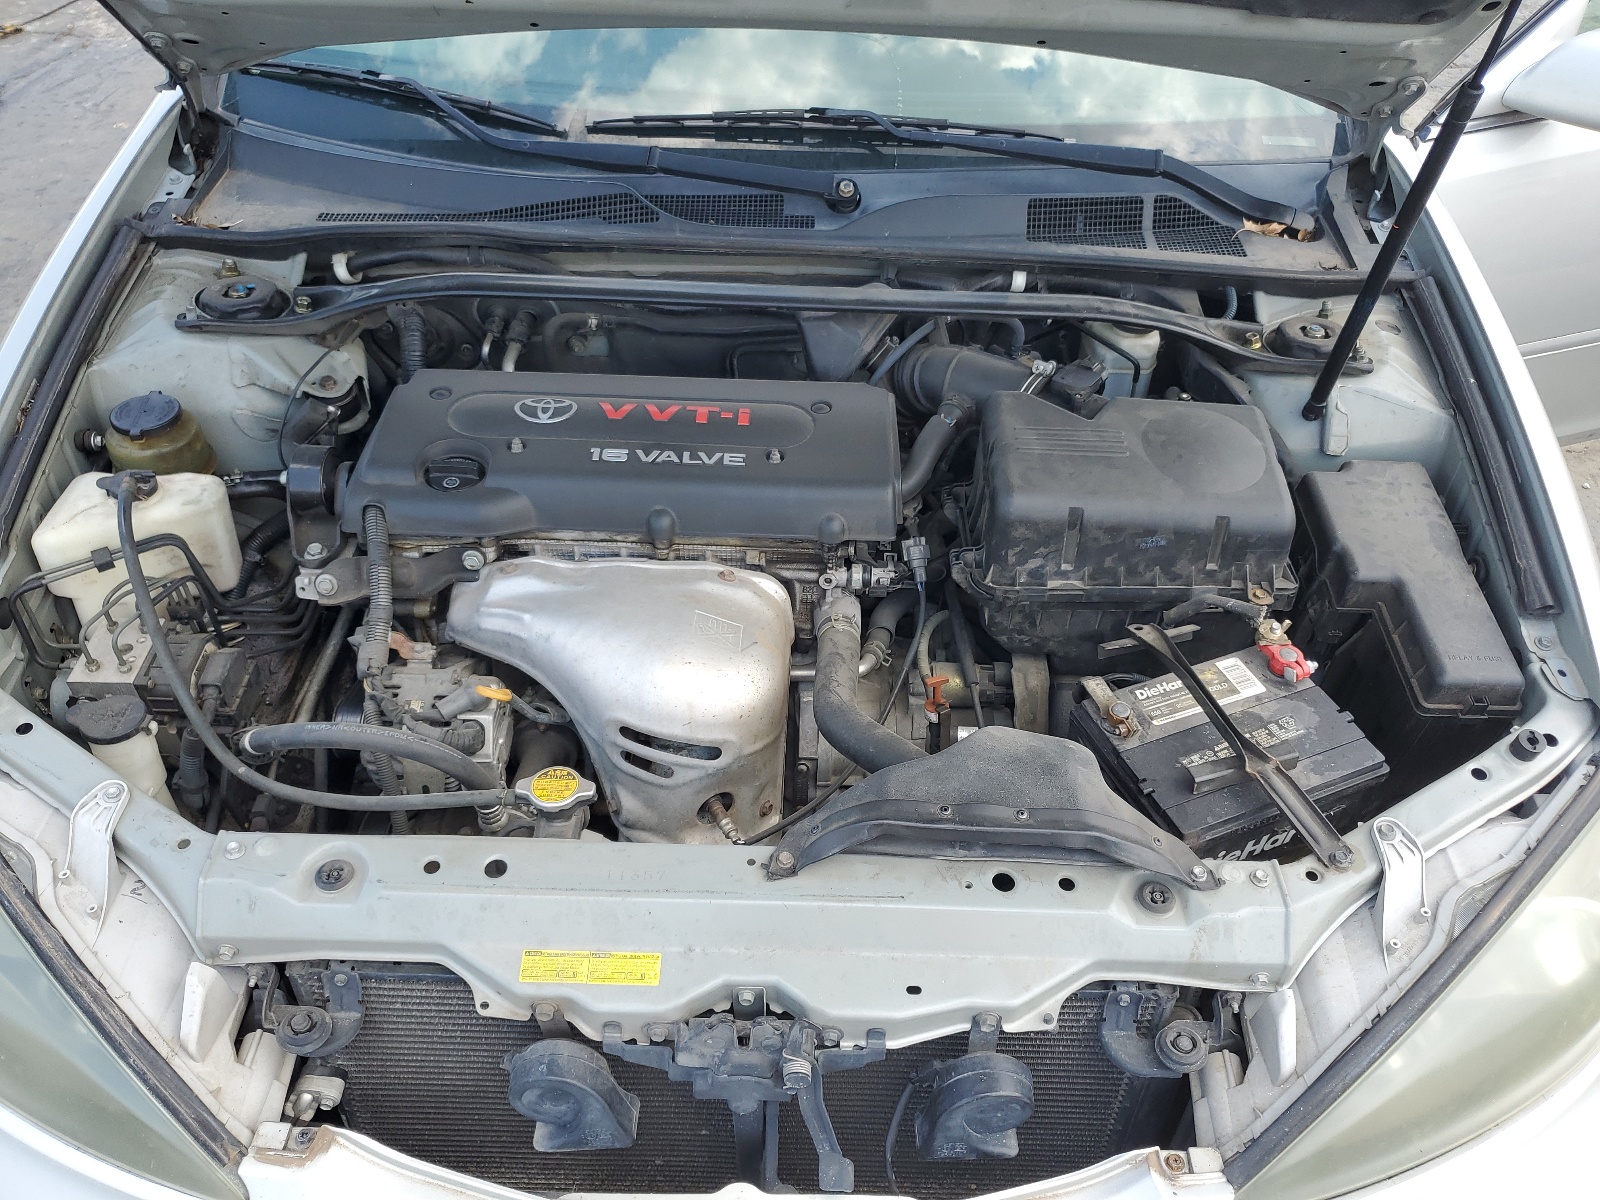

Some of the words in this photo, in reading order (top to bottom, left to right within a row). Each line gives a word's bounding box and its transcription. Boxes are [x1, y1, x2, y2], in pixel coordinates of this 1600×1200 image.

[599, 402, 751, 426] VVT-i
[590, 447, 629, 462] 16
[635, 449, 746, 467] VALVE
[1134, 680, 1183, 701] DieHar
[1200, 829, 1297, 861] ieHar
